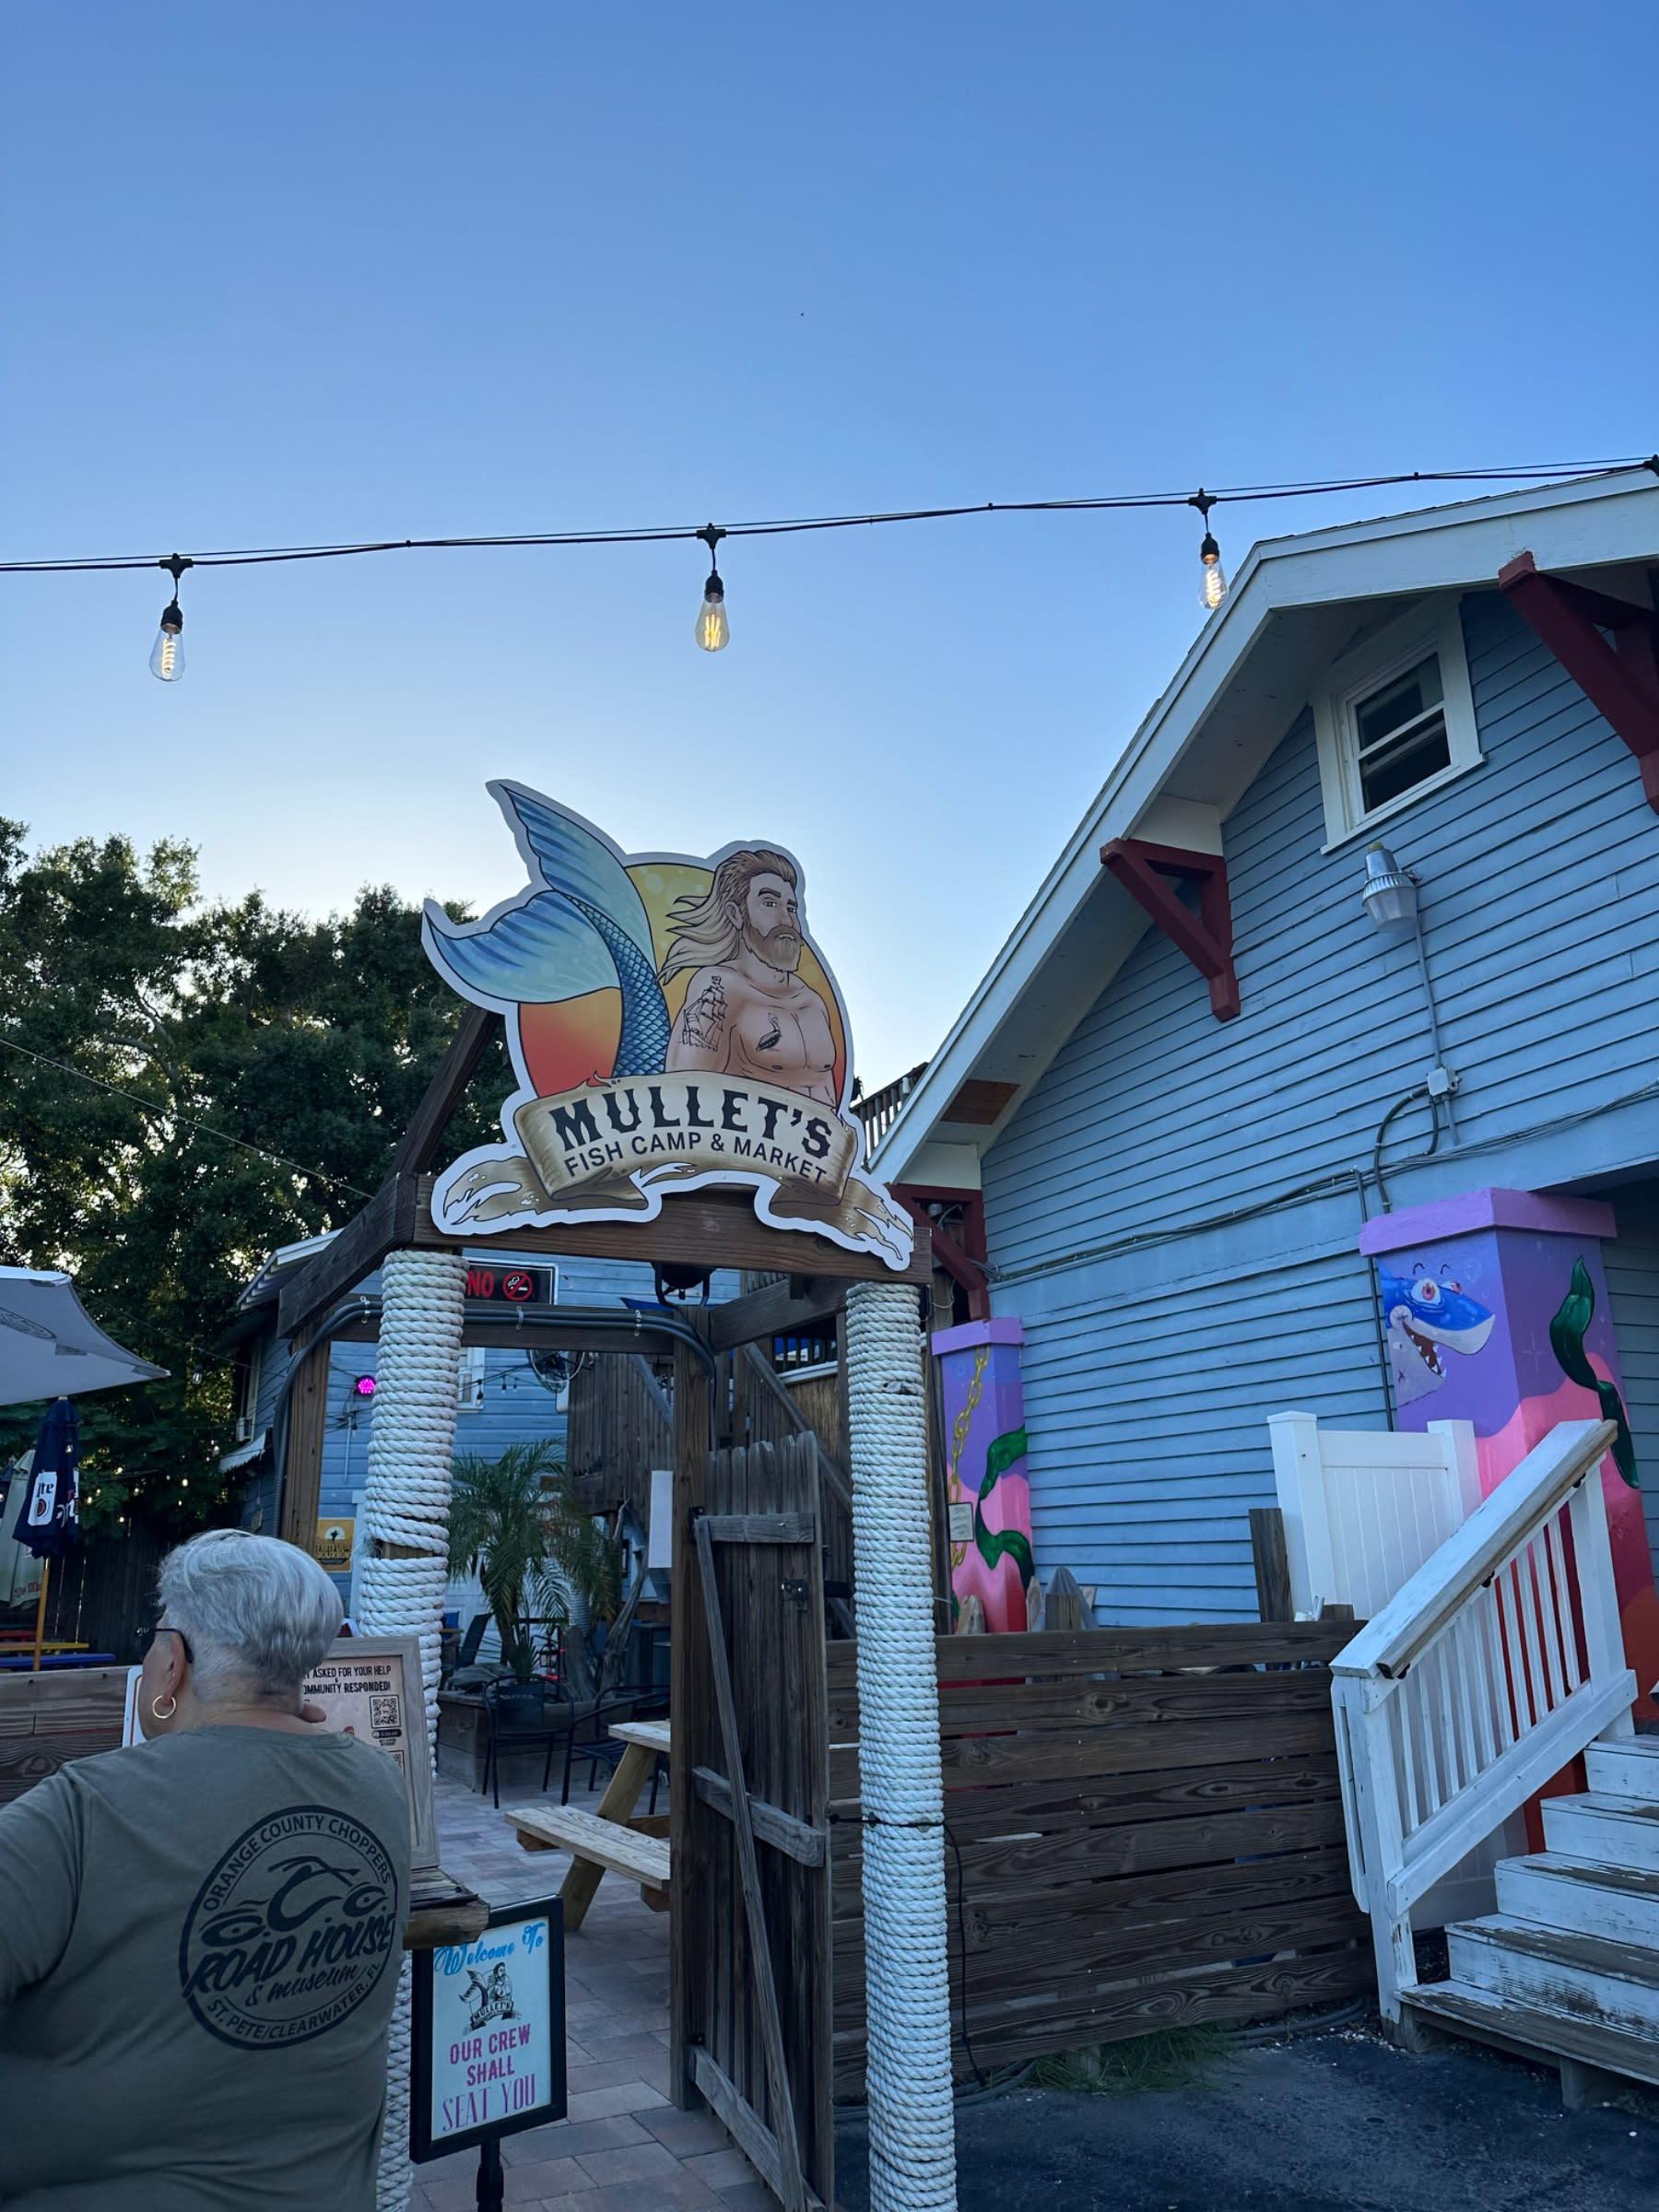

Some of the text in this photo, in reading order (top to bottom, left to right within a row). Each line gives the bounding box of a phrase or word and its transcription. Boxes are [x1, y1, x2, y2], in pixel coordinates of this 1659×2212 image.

[548, 1086, 832, 1159] MULLET'S
[565, 1132, 827, 1184] FISH CAMP & MARKET
[466, 1270, 495, 1298] NO
[303, 1681, 391, 1695] OMMUNITY RESPONDED!
[313, 1668, 336, 1678] ASKED
[338, 1666, 352, 1677] FOR
[354, 1665, 372, 1677] YOUR
[373, 1665, 392, 1676] HELP
[203, 1815, 392, 1912] ORANGE COUNTY CHOPPERS
[182, 1936, 297, 1998] ROAD
[434, 1922, 546, 1976] Welcome To
[207, 1998, 229, 2023] ST.
[449, 2023, 531, 2065] OUR CREW
[466, 2054, 515, 2087] SHALL
[442, 2074, 536, 2132] SEAT YOU
